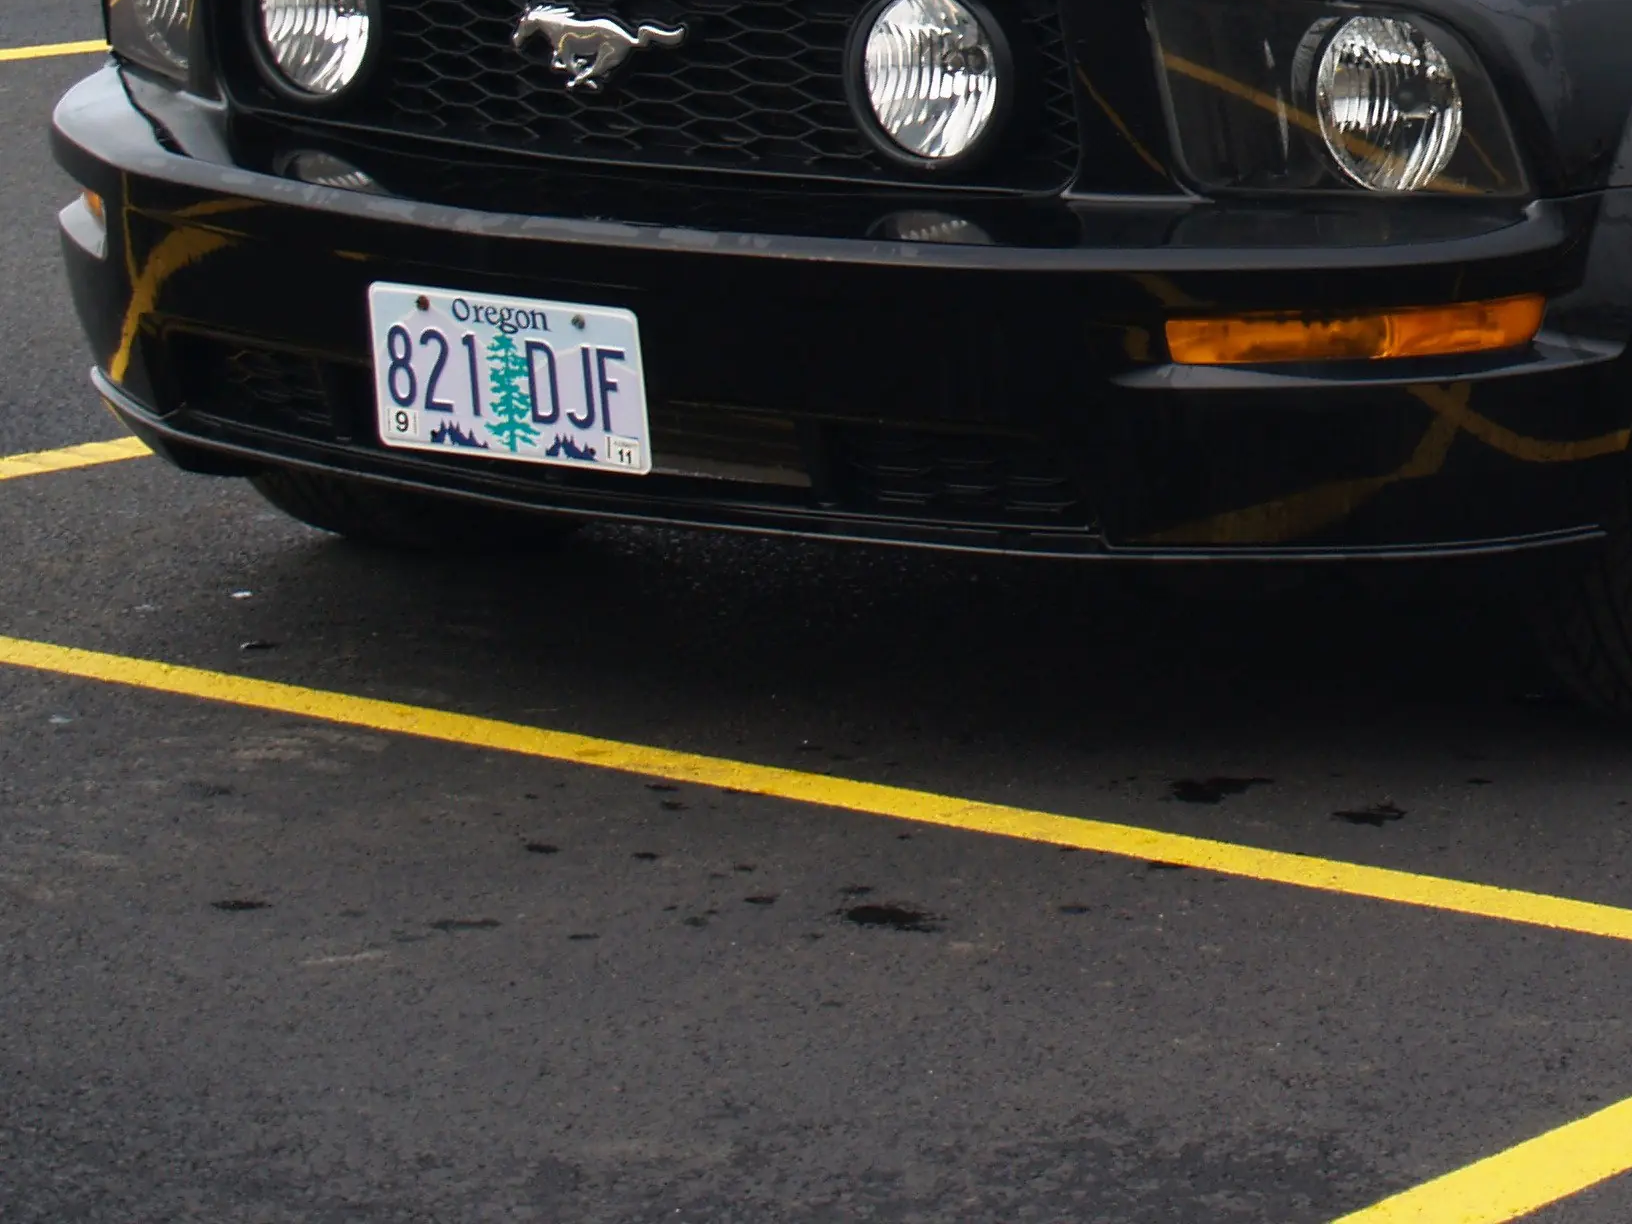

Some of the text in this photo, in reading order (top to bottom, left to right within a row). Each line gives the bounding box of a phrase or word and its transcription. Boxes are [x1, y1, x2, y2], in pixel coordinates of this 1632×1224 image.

[452, 297, 551, 335] Oregon
[387, 323, 625, 432] 821 DJF
[395, 411, 409, 432] 9
[618, 448, 632, 464] 11
